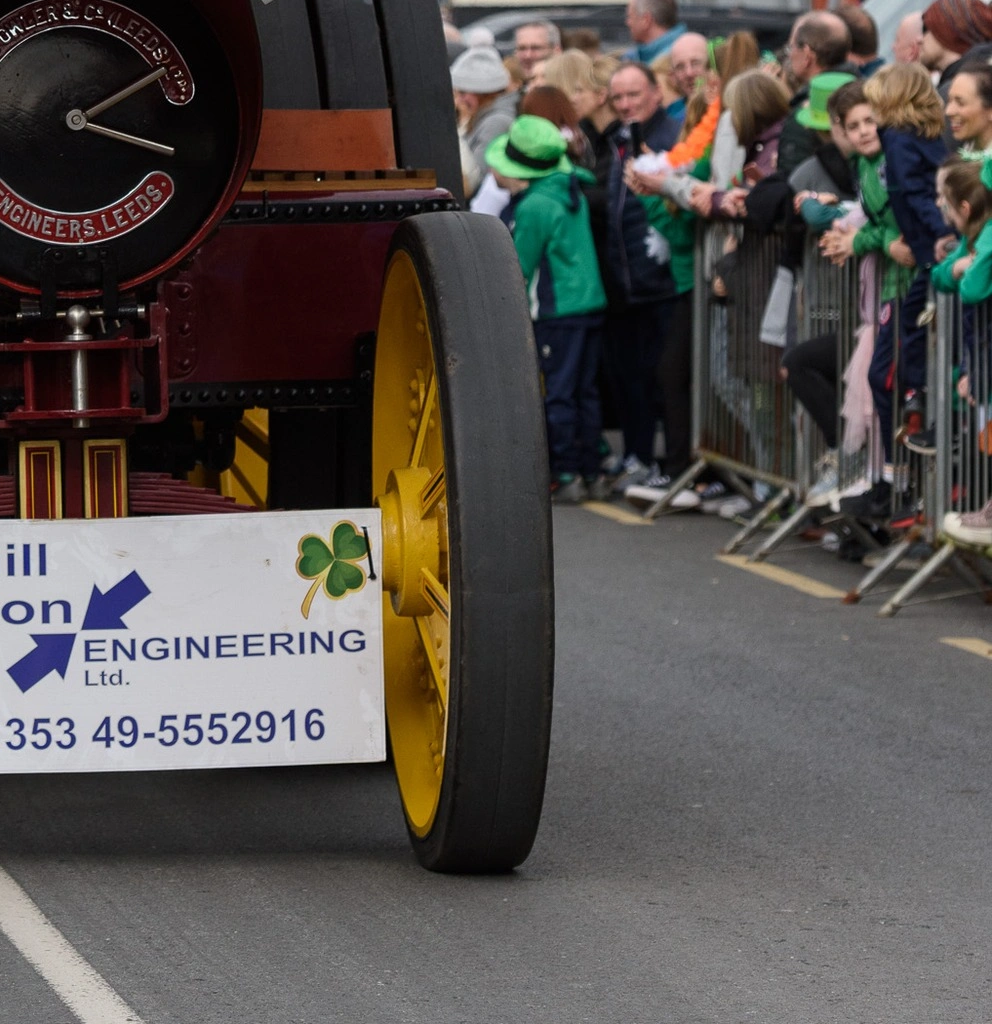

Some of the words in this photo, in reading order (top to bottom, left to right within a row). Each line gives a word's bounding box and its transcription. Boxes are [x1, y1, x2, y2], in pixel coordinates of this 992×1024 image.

[62, 3, 80, 20] &
[107, 11, 171, 66] (LEEDS)
[101, 183, 164, 233] LEEDS
[83, 629, 367, 662] ENGINEERING
[84, 669, 130, 686] Ltd.
[5, 717, 77, 750] 353
[92, 708, 326, 749] 49-5552916
